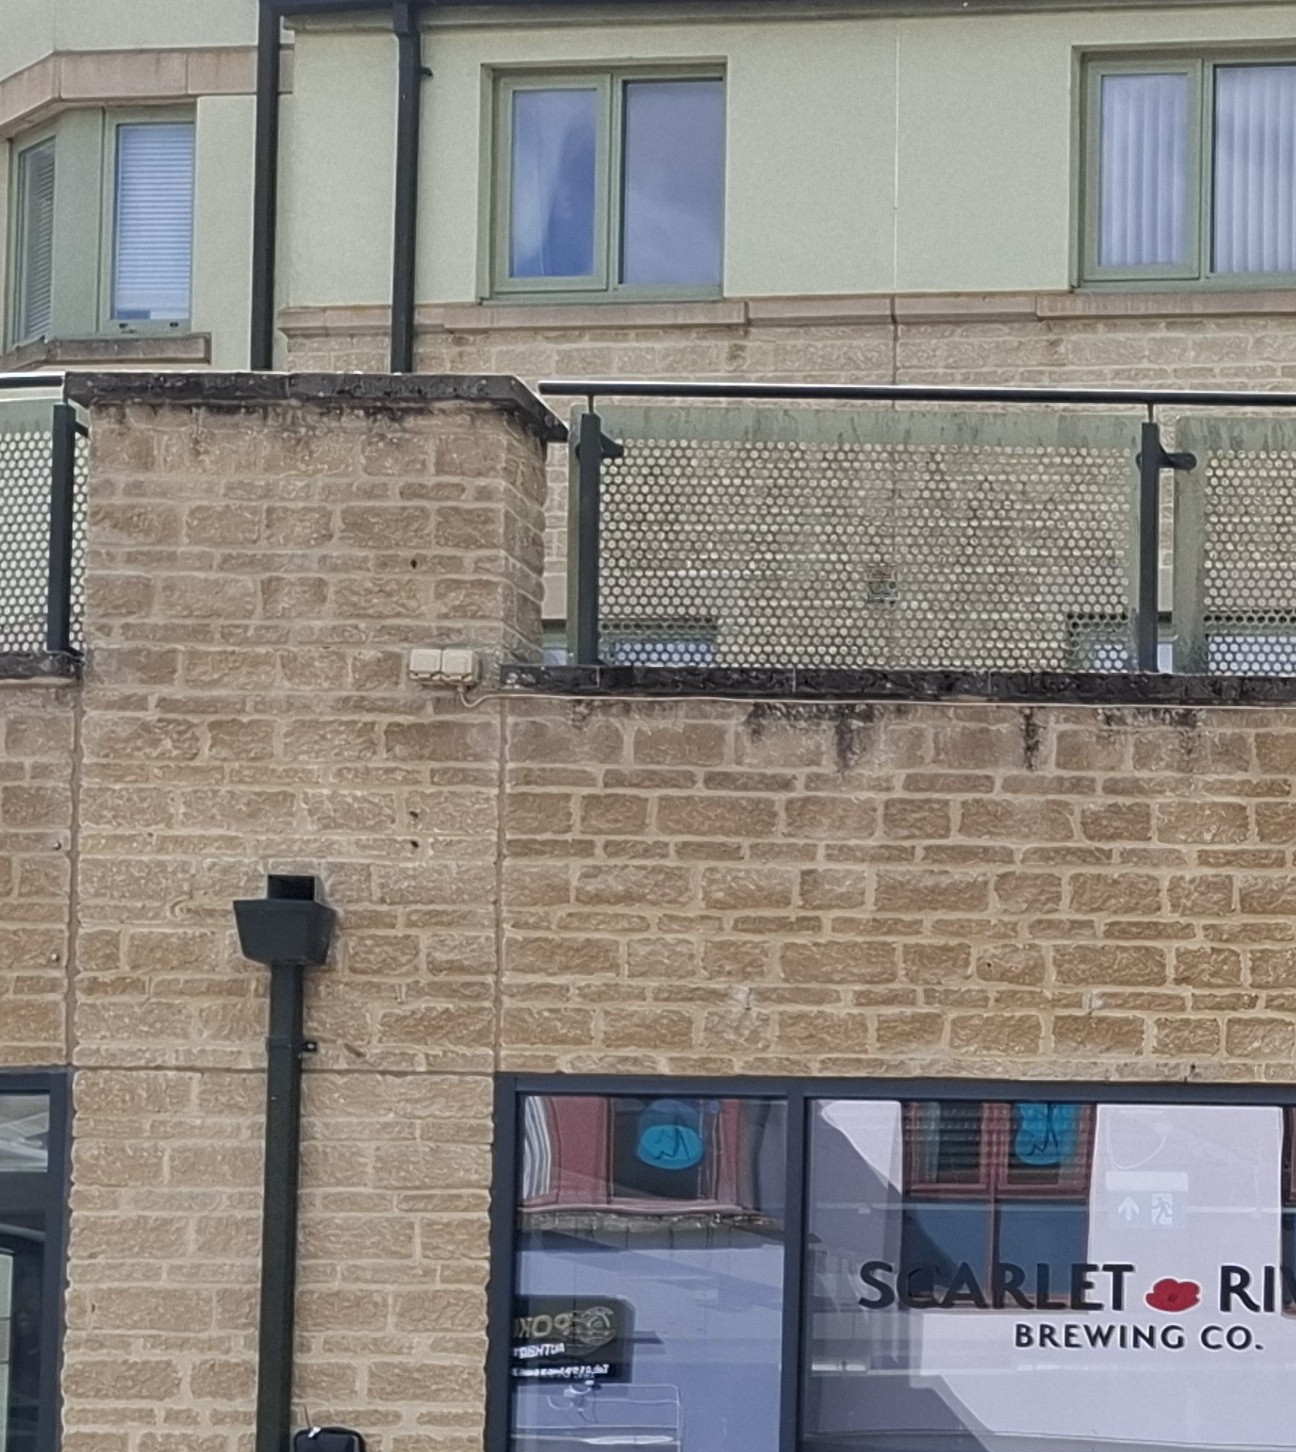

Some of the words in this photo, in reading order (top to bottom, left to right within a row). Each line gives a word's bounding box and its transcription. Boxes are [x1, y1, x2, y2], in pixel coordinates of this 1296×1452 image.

[858, 1260, 1136, 1312] SCARLET
[1015, 1322, 1186, 1350] BREWING
[1200, 1324, 1265, 1352] CO.
